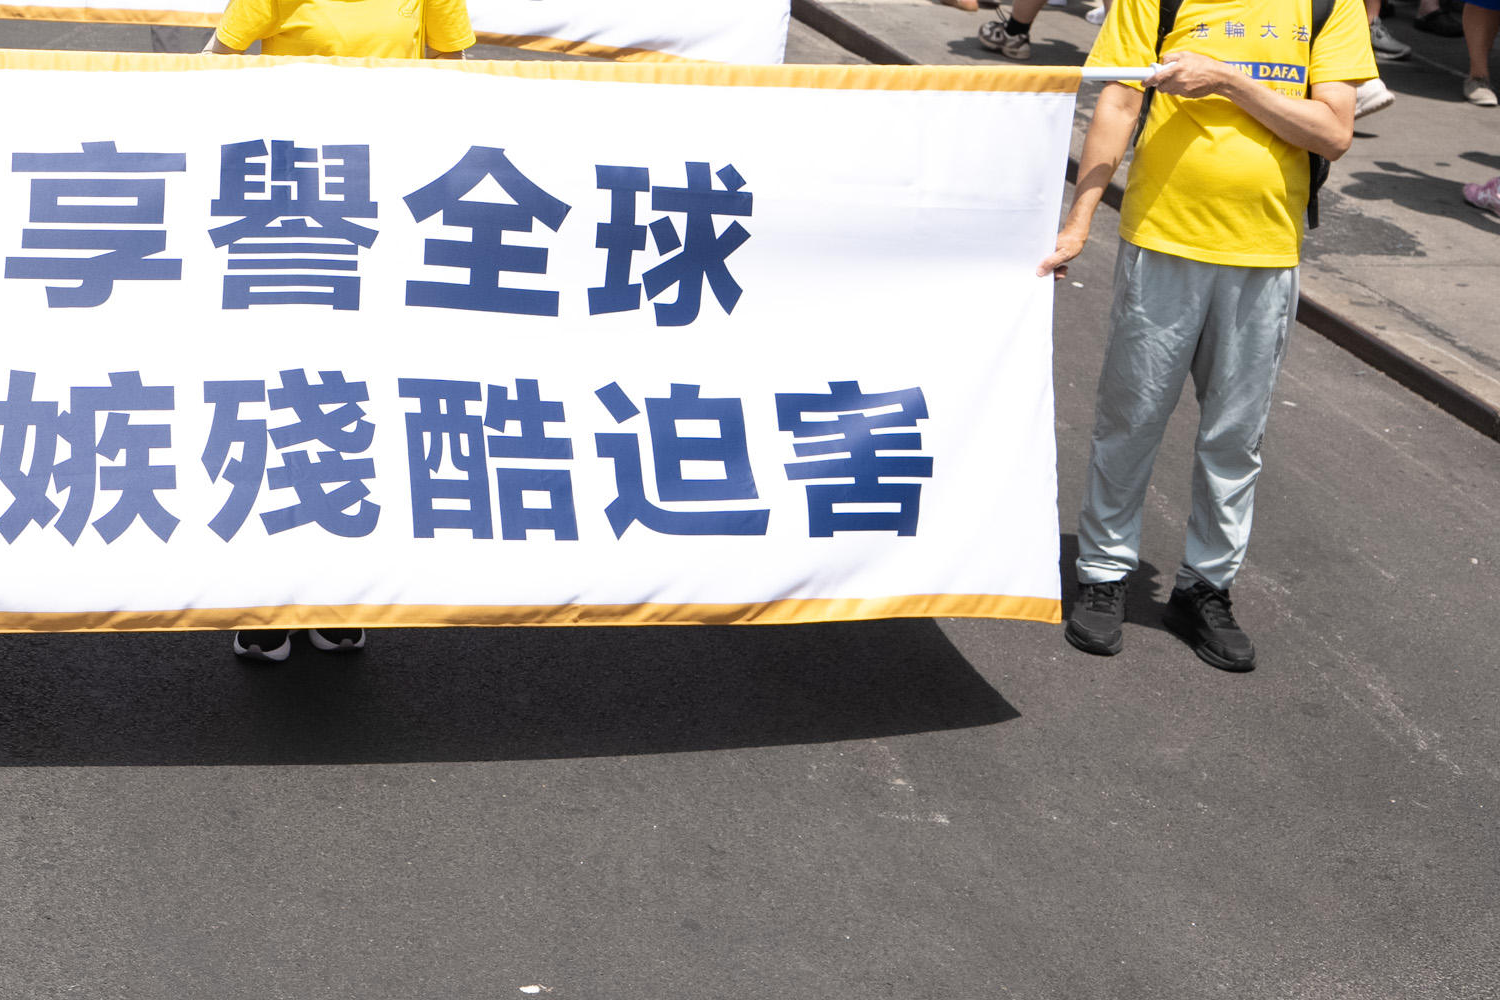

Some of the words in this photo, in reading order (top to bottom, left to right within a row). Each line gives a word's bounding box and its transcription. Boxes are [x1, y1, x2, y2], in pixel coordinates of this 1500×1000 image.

[1190, 20, 1310, 42] 法輪大法
[1259, 65, 1300, 81] DAFA
